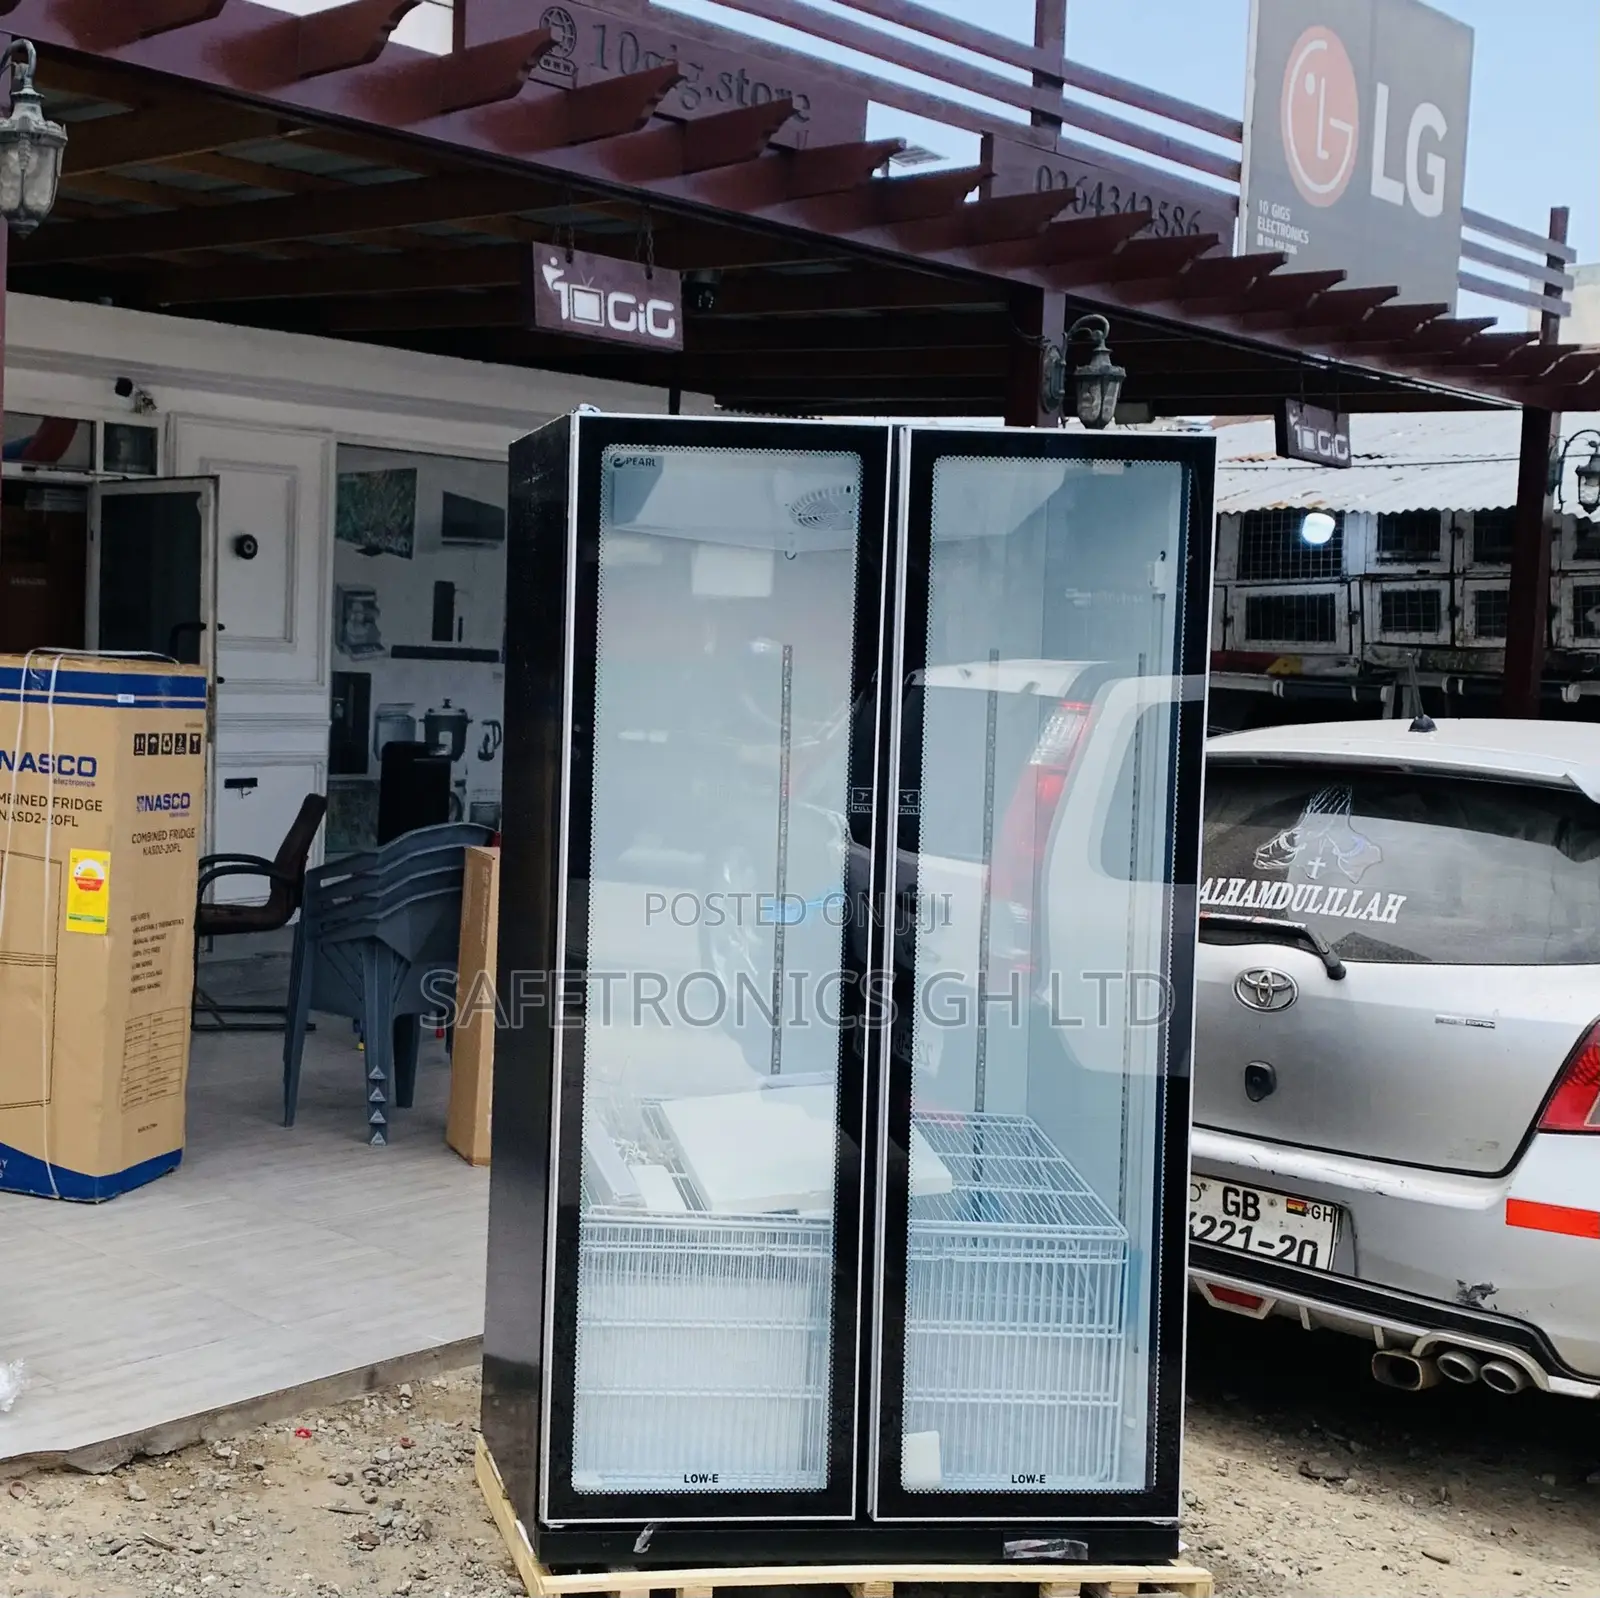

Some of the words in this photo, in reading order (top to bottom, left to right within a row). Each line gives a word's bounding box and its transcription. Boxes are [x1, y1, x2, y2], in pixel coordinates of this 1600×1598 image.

[1370, 81, 1448, 218] LG
[1257, 215, 1309, 244] ELECTRONICS
[0, 750, 97, 777] NASCO
[52, 797, 103, 812] FRIDGE
[145, 793, 191, 811] NASCO
[132, 831, 168, 844] COMBINED
[169, 827, 196, 841] FRIDGE
[1199, 877, 1407, 924] ALHAMDULILLAH
[1222, 1186, 1260, 1222] GB
[1310, 1204, 1333, 1223] GH
